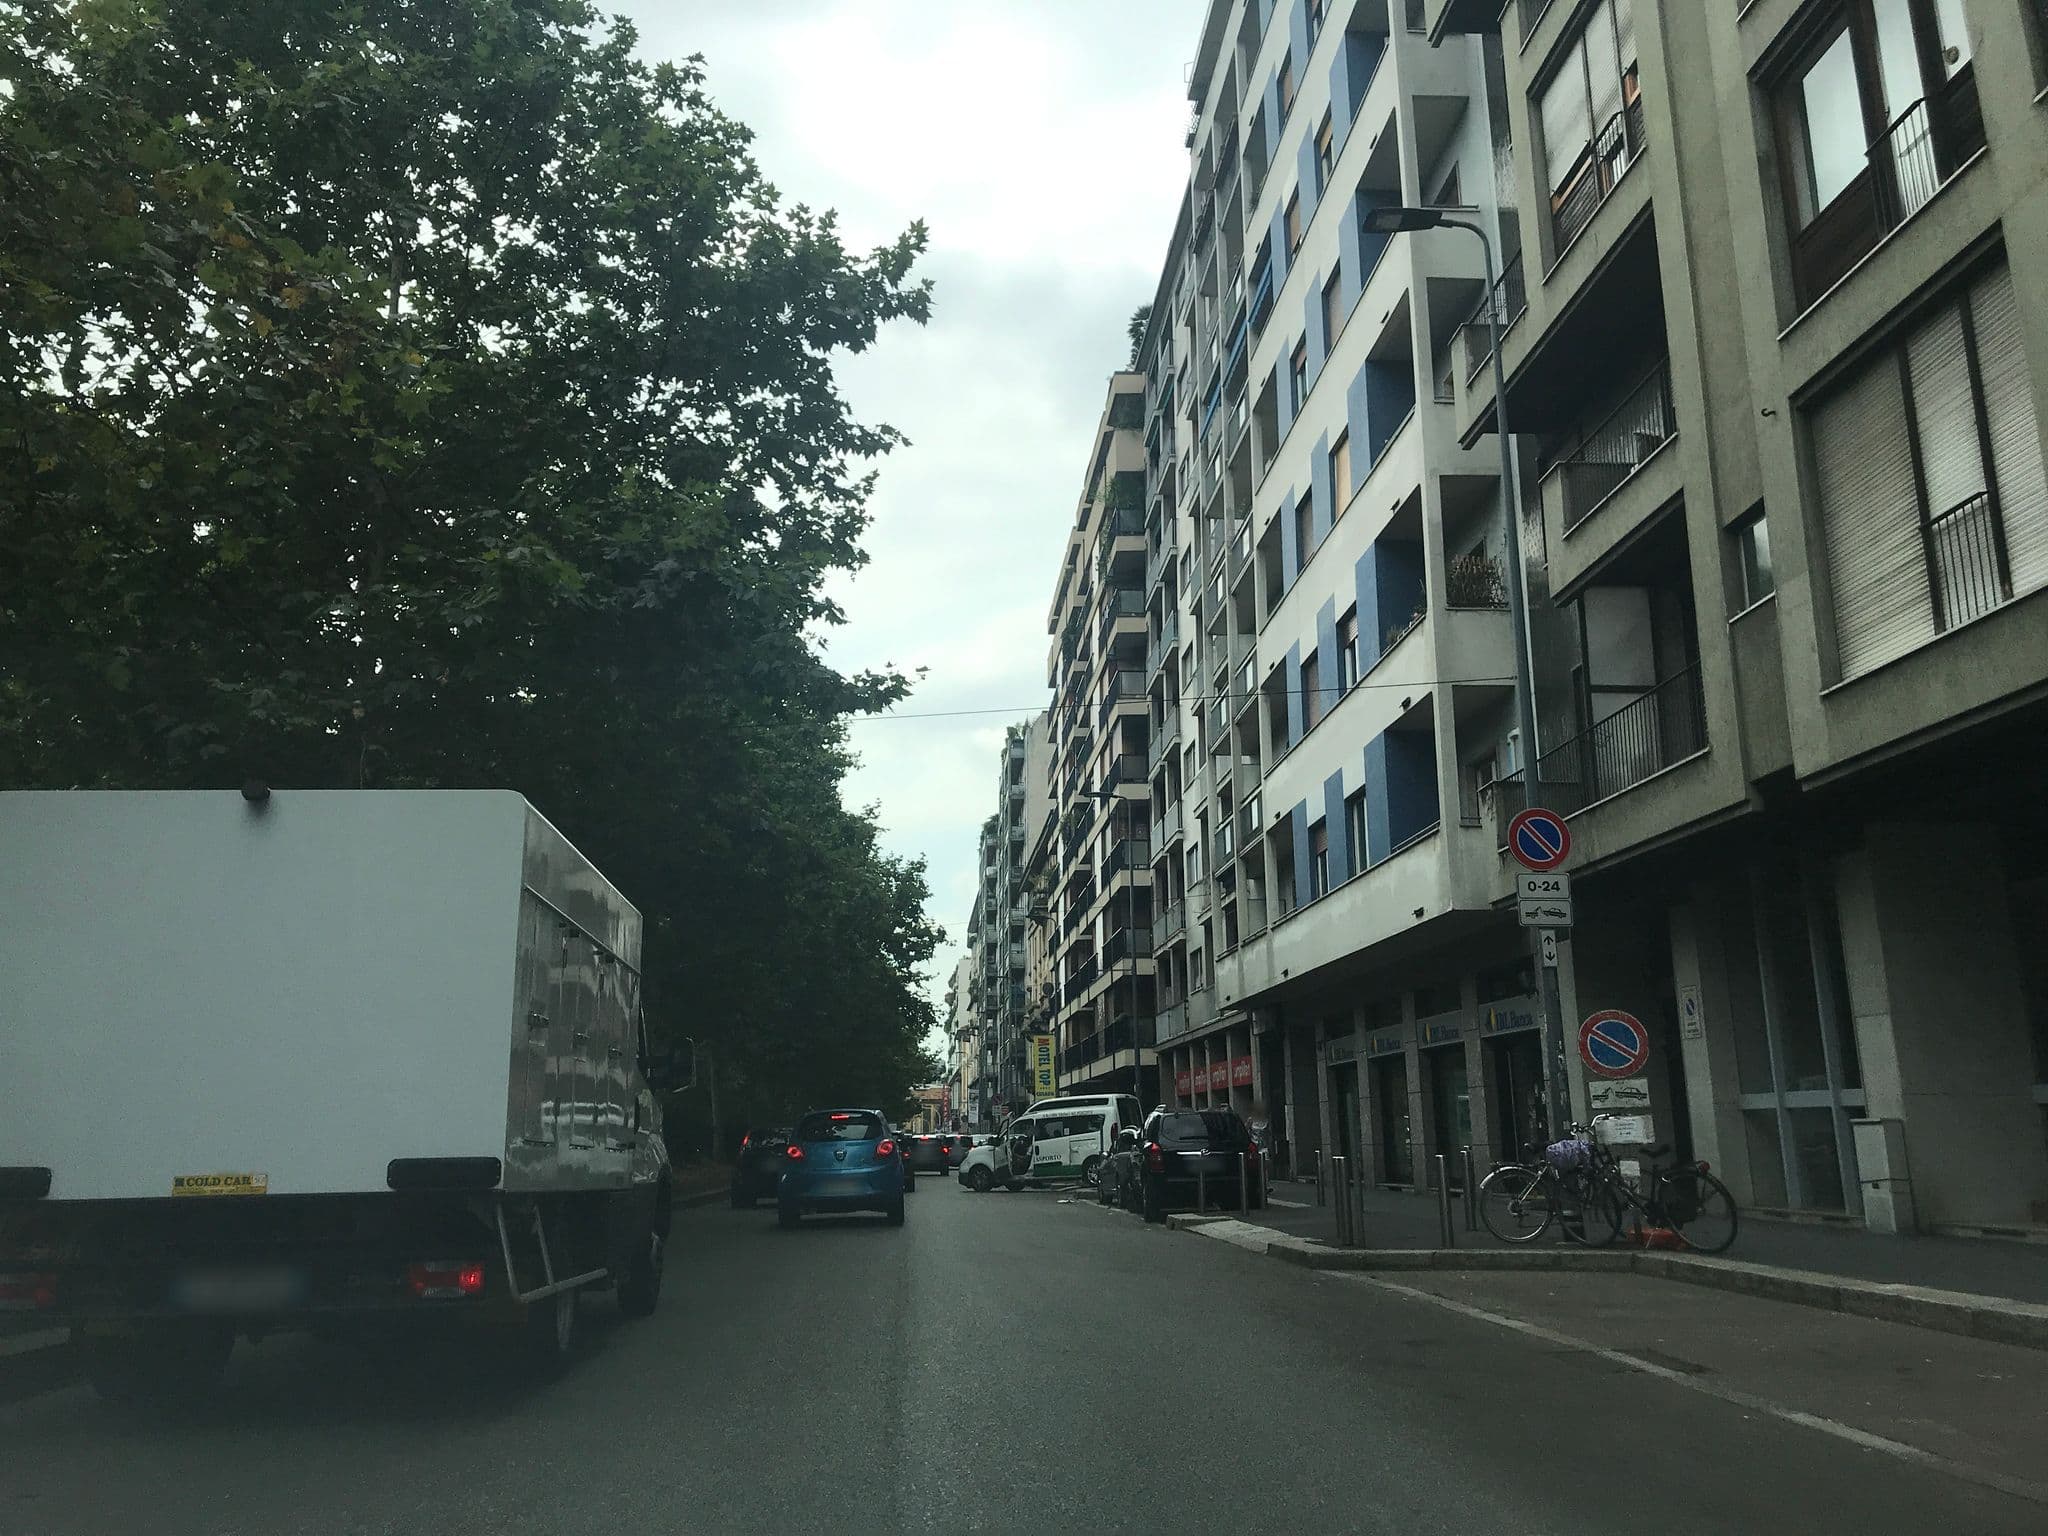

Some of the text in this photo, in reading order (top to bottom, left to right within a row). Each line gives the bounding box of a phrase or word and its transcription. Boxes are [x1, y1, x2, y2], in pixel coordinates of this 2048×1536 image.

[1527, 880, 1561, 893] 0-24
[1039, 1069, 1051, 1086] TOP
[186, 1176, 252, 1187] COLD CAR
